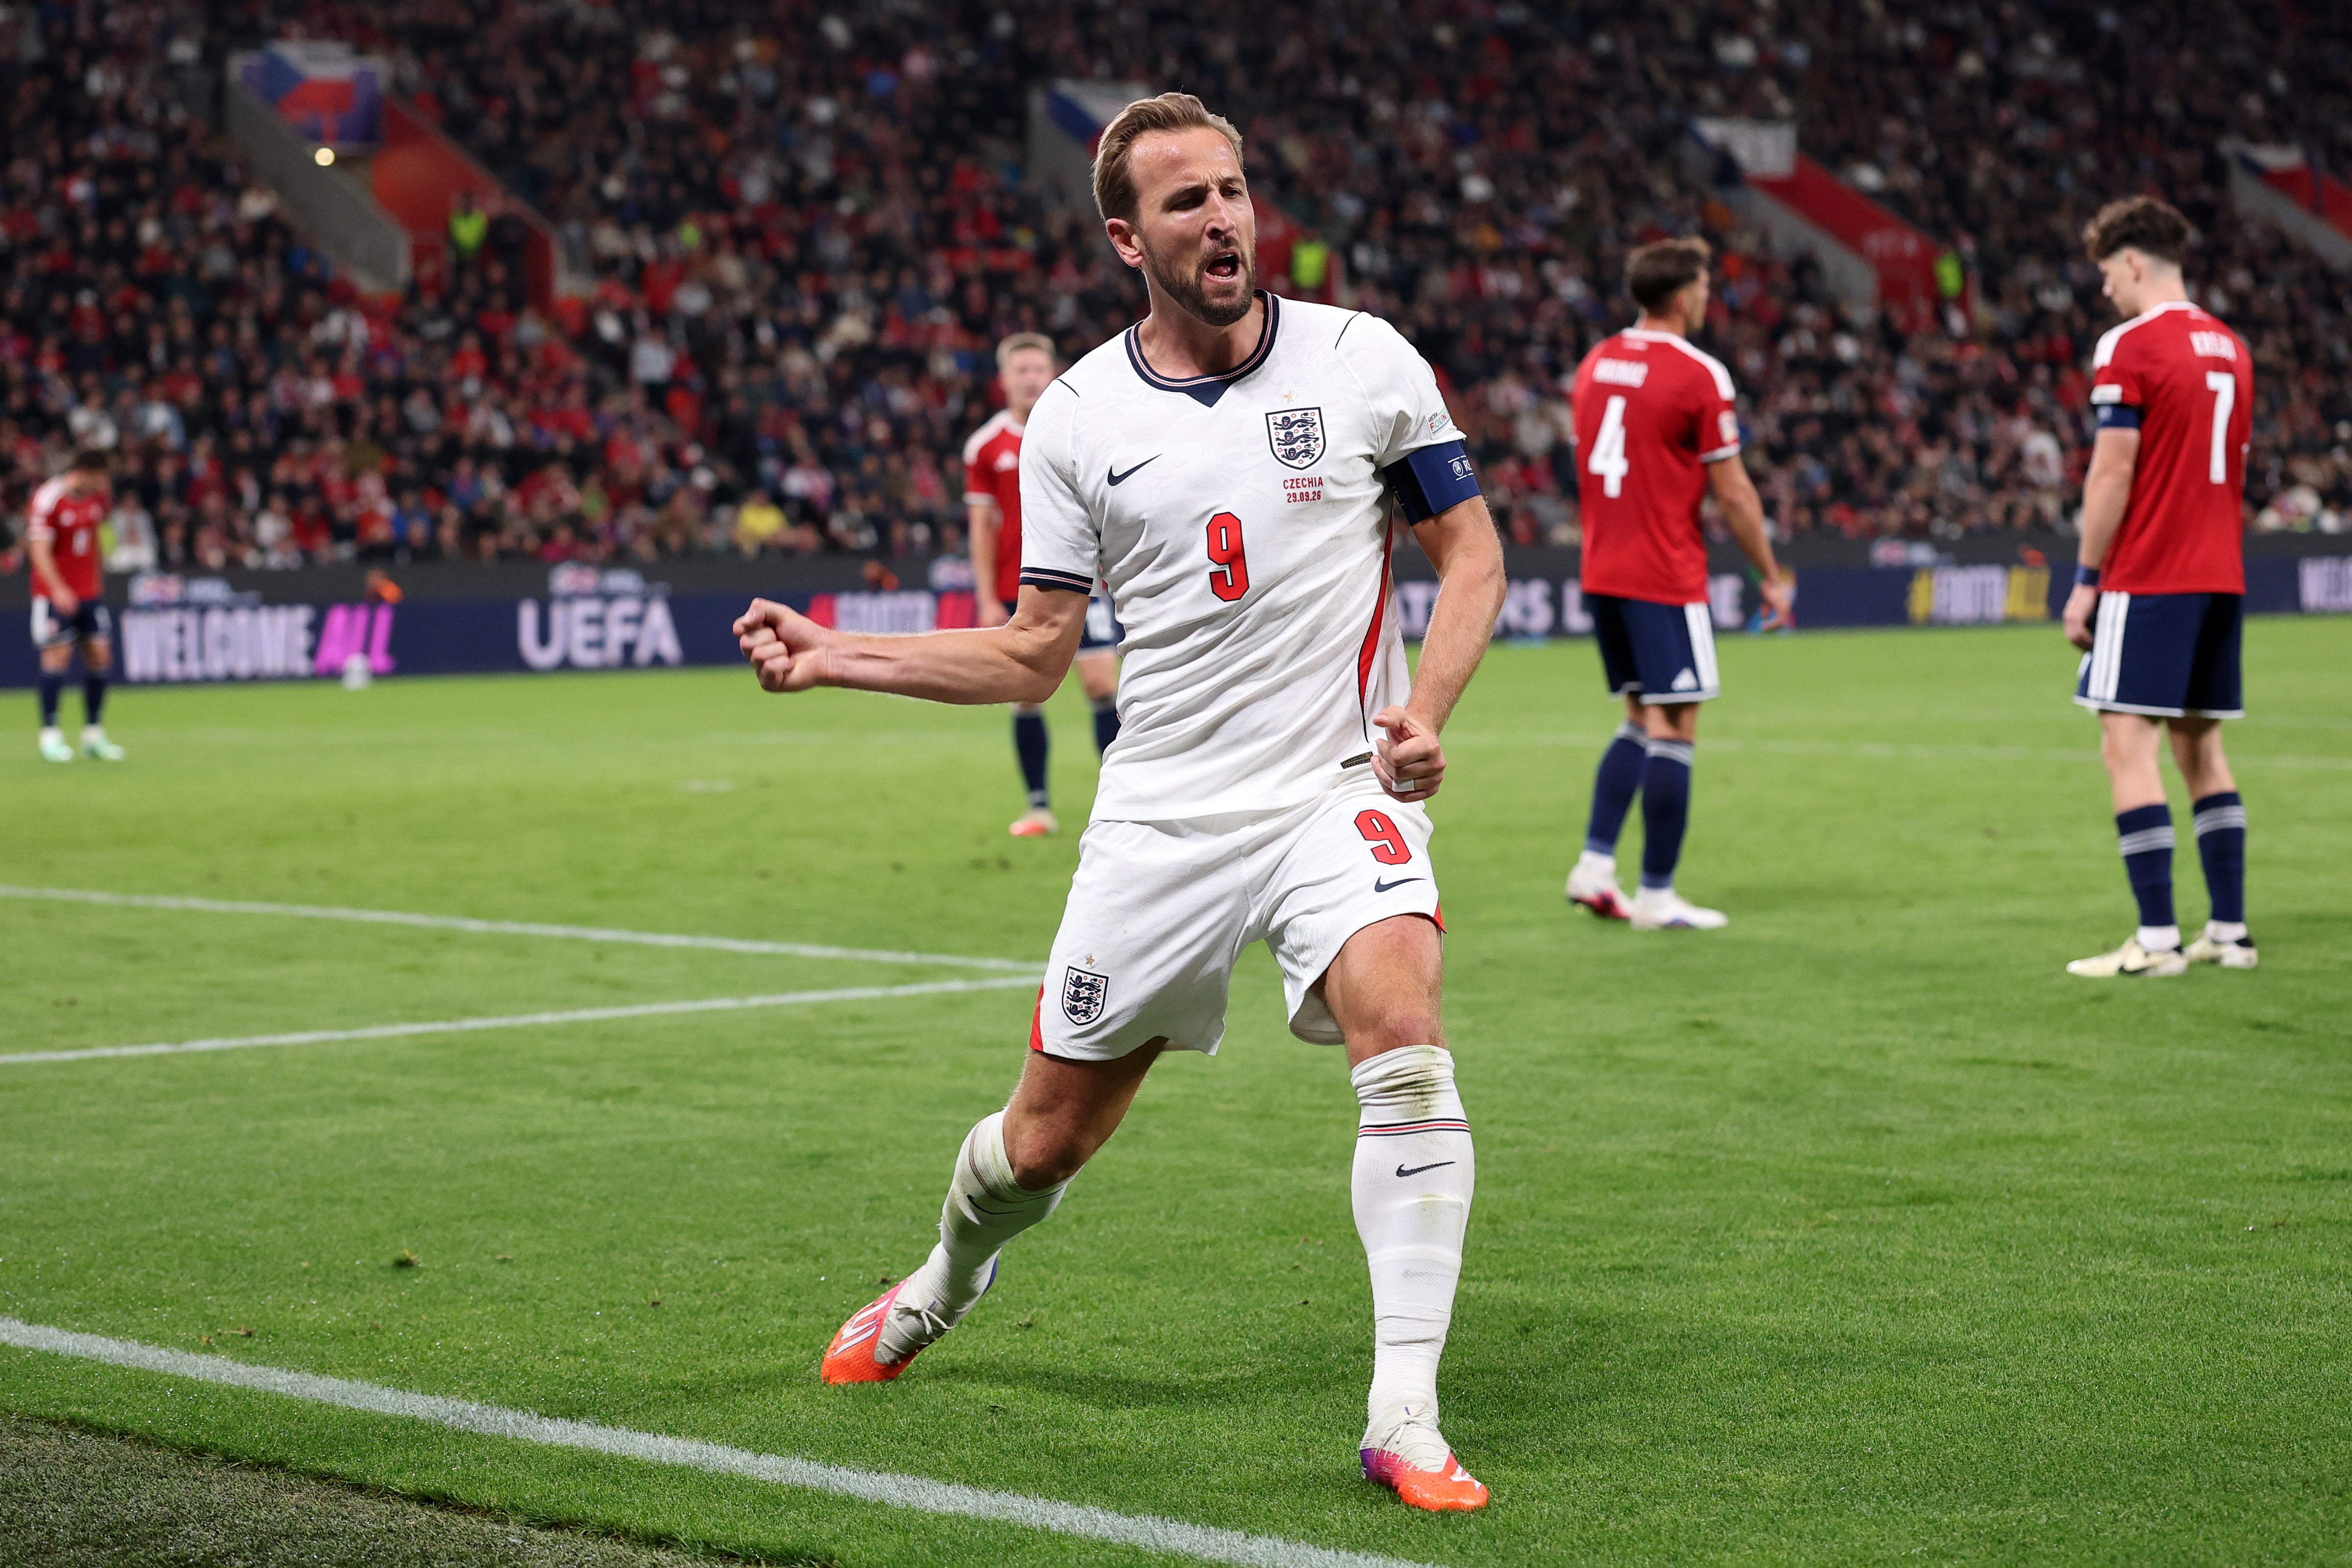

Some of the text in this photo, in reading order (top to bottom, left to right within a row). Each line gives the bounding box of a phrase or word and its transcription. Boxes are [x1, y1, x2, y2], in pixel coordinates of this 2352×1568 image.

[1587, 394, 1629, 499] 4
[2205, 370, 2236, 484] 7
[1283, 476, 1324, 489] CZECHIA
[1287, 490, 1321, 503] 29.09.26
[1206, 511, 1249, 602] 9
[121, 604, 316, 682] WELCOME
[517, 597, 683, 670] UEFA
[1354, 809, 1412, 865] 9
